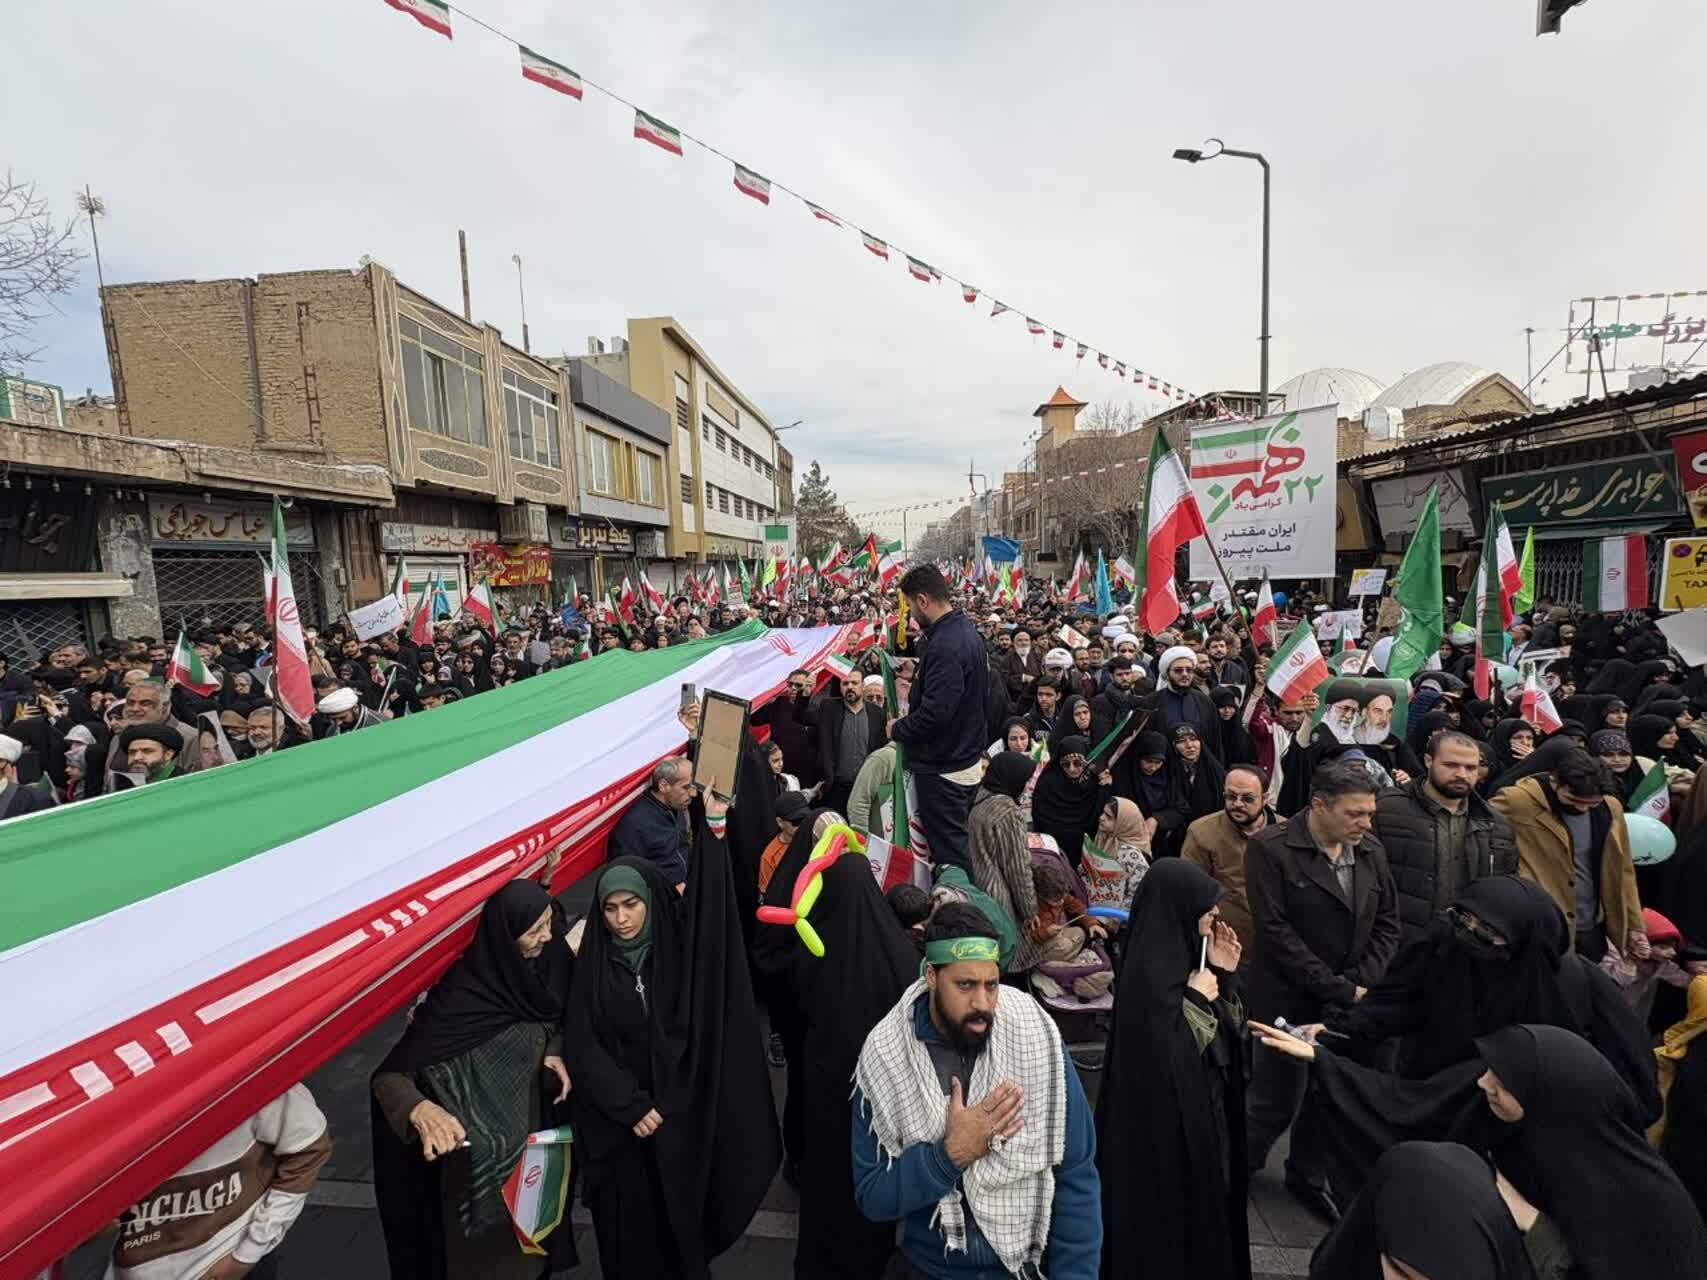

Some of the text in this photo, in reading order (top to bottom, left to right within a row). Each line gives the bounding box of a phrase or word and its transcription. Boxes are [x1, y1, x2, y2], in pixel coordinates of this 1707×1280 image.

[1284, 474, 1324, 504] ۲۲
[1499, 476, 1582, 517] خداپرست
[1561, 467, 1665, 517] جواهری
[578, 521, 608, 549] تبریز
[1223, 523, 1297, 542] ایران مقتدر
[1217, 542, 1292, 560] ملت پیروز
[123, 1231, 162, 1250] PARIS
